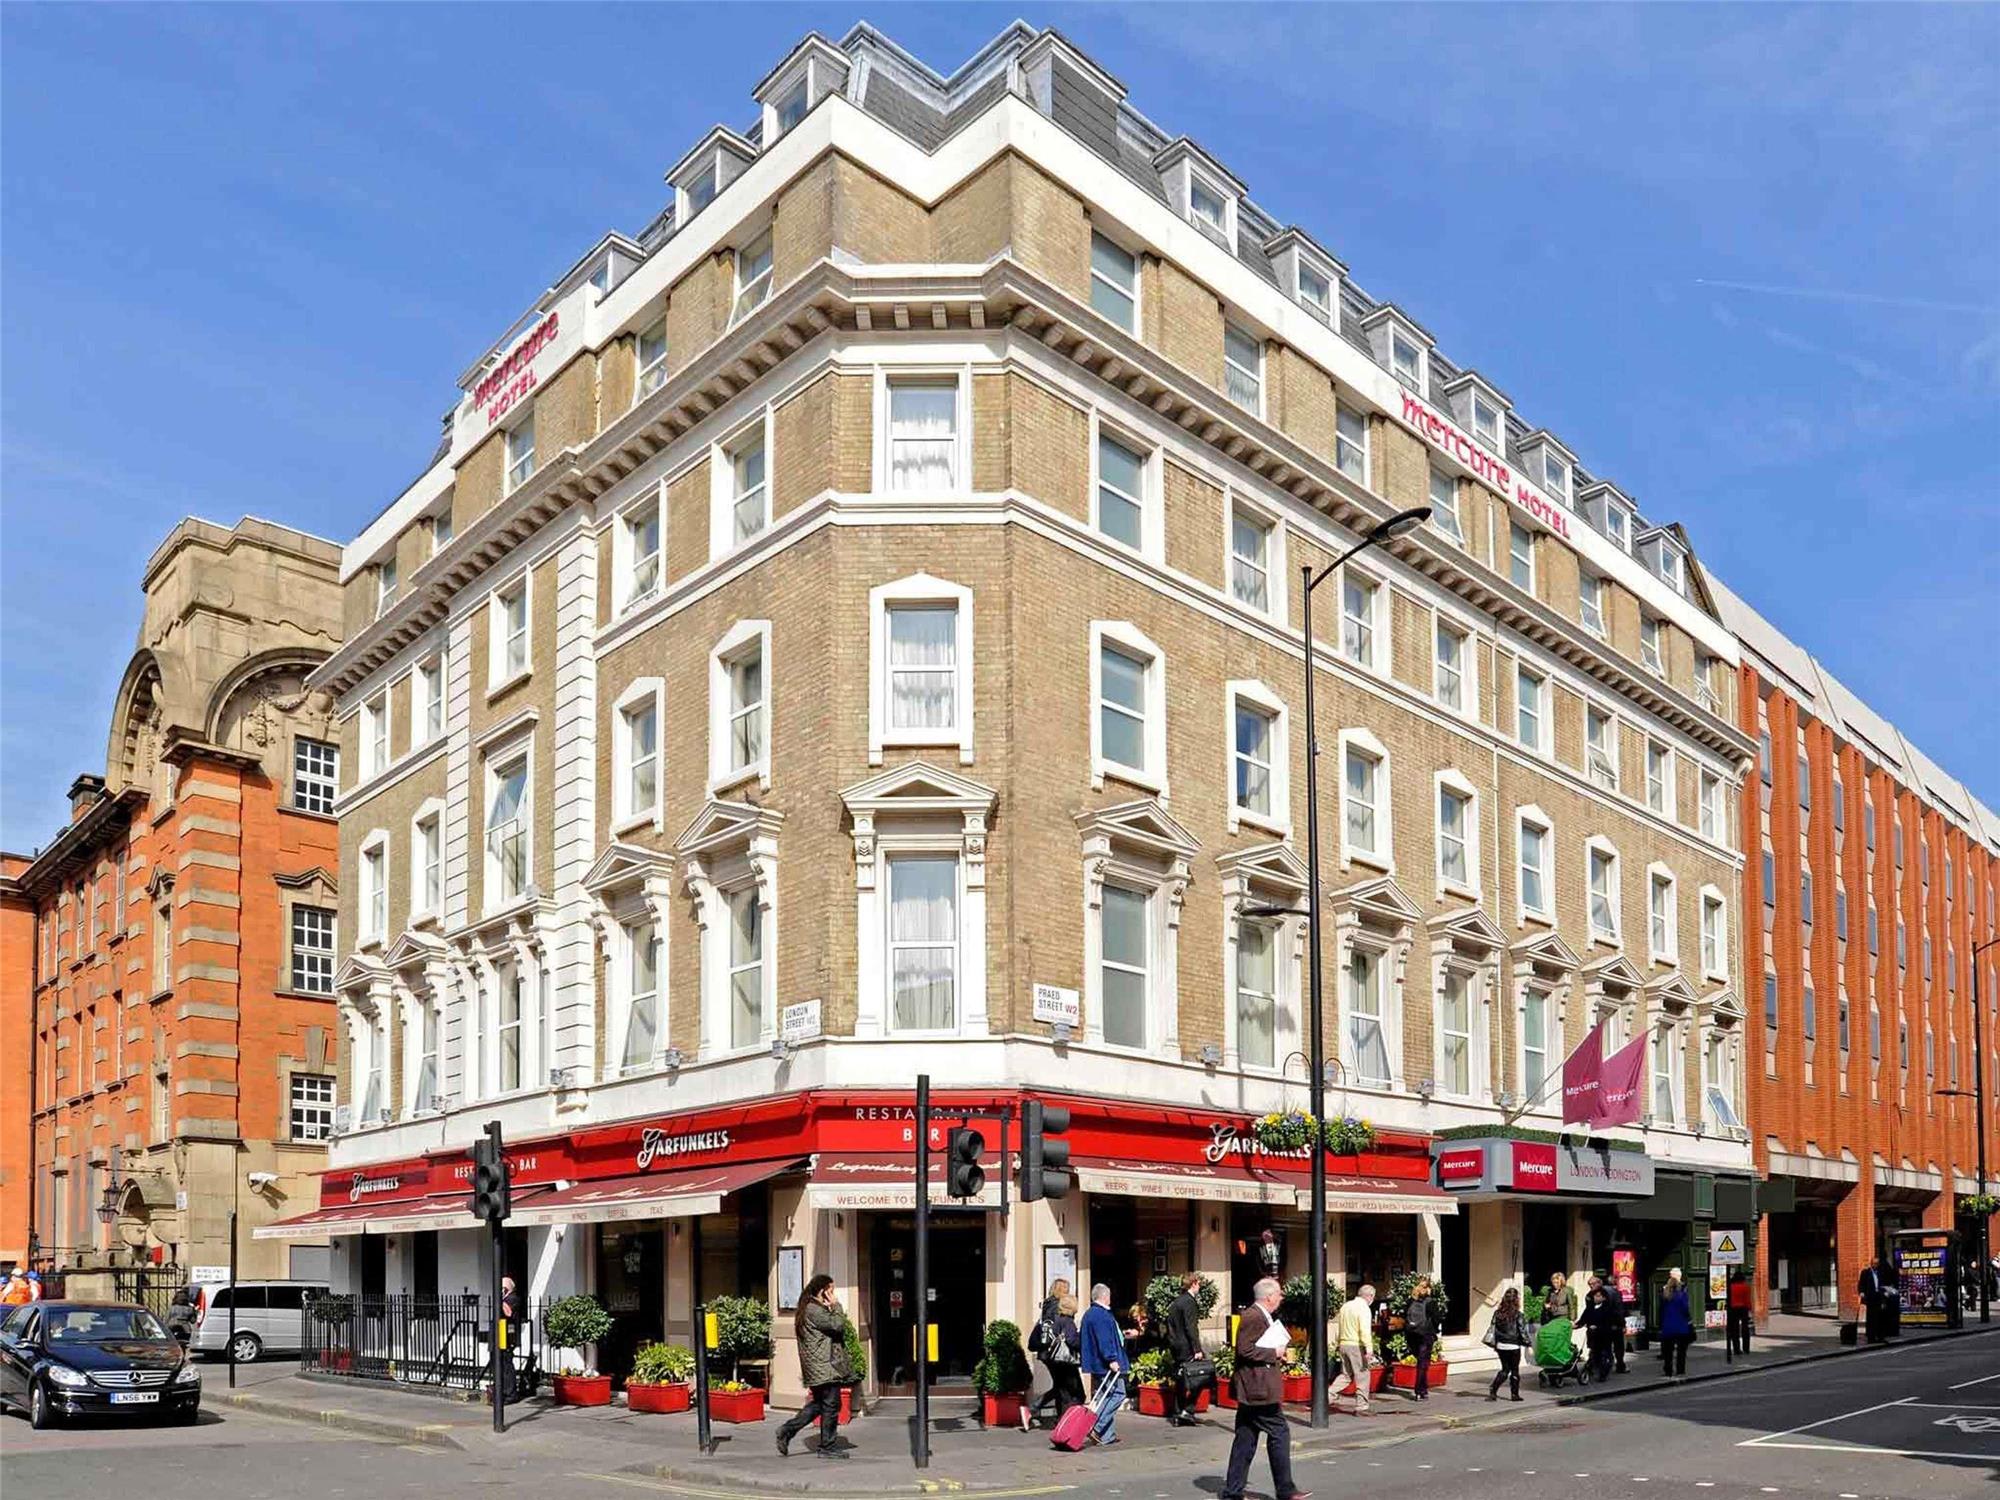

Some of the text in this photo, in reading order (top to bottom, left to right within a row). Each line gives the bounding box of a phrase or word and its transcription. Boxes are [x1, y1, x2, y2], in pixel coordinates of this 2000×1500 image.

[487, 369, 537, 425] HOTEL
[1517, 483, 1570, 538] HOTEL
[1038, 987, 1060, 1001] PRAED
[785, 1005, 808, 1019] LONDON
[1038, 999, 1078, 1015] STREET W2
[785, 1017, 805, 1030] STREET
[903, 1128, 940, 1142] BR
[637, 1127, 729, 1169] GARFUNKEL'S
[520, 1158, 537, 1171] BAR
[1443, 1159, 1476, 1170] Mercure
[1519, 1160, 1553, 1176] Mercure
[1570, 1164, 1600, 1177] LONDON
[1141, 1184, 1163, 1194] WINES
[1174, 1187, 1205, 1197] COFFEES
[837, 1195, 893, 1206] WELCOME
[895, 1195, 908, 1206] TO
